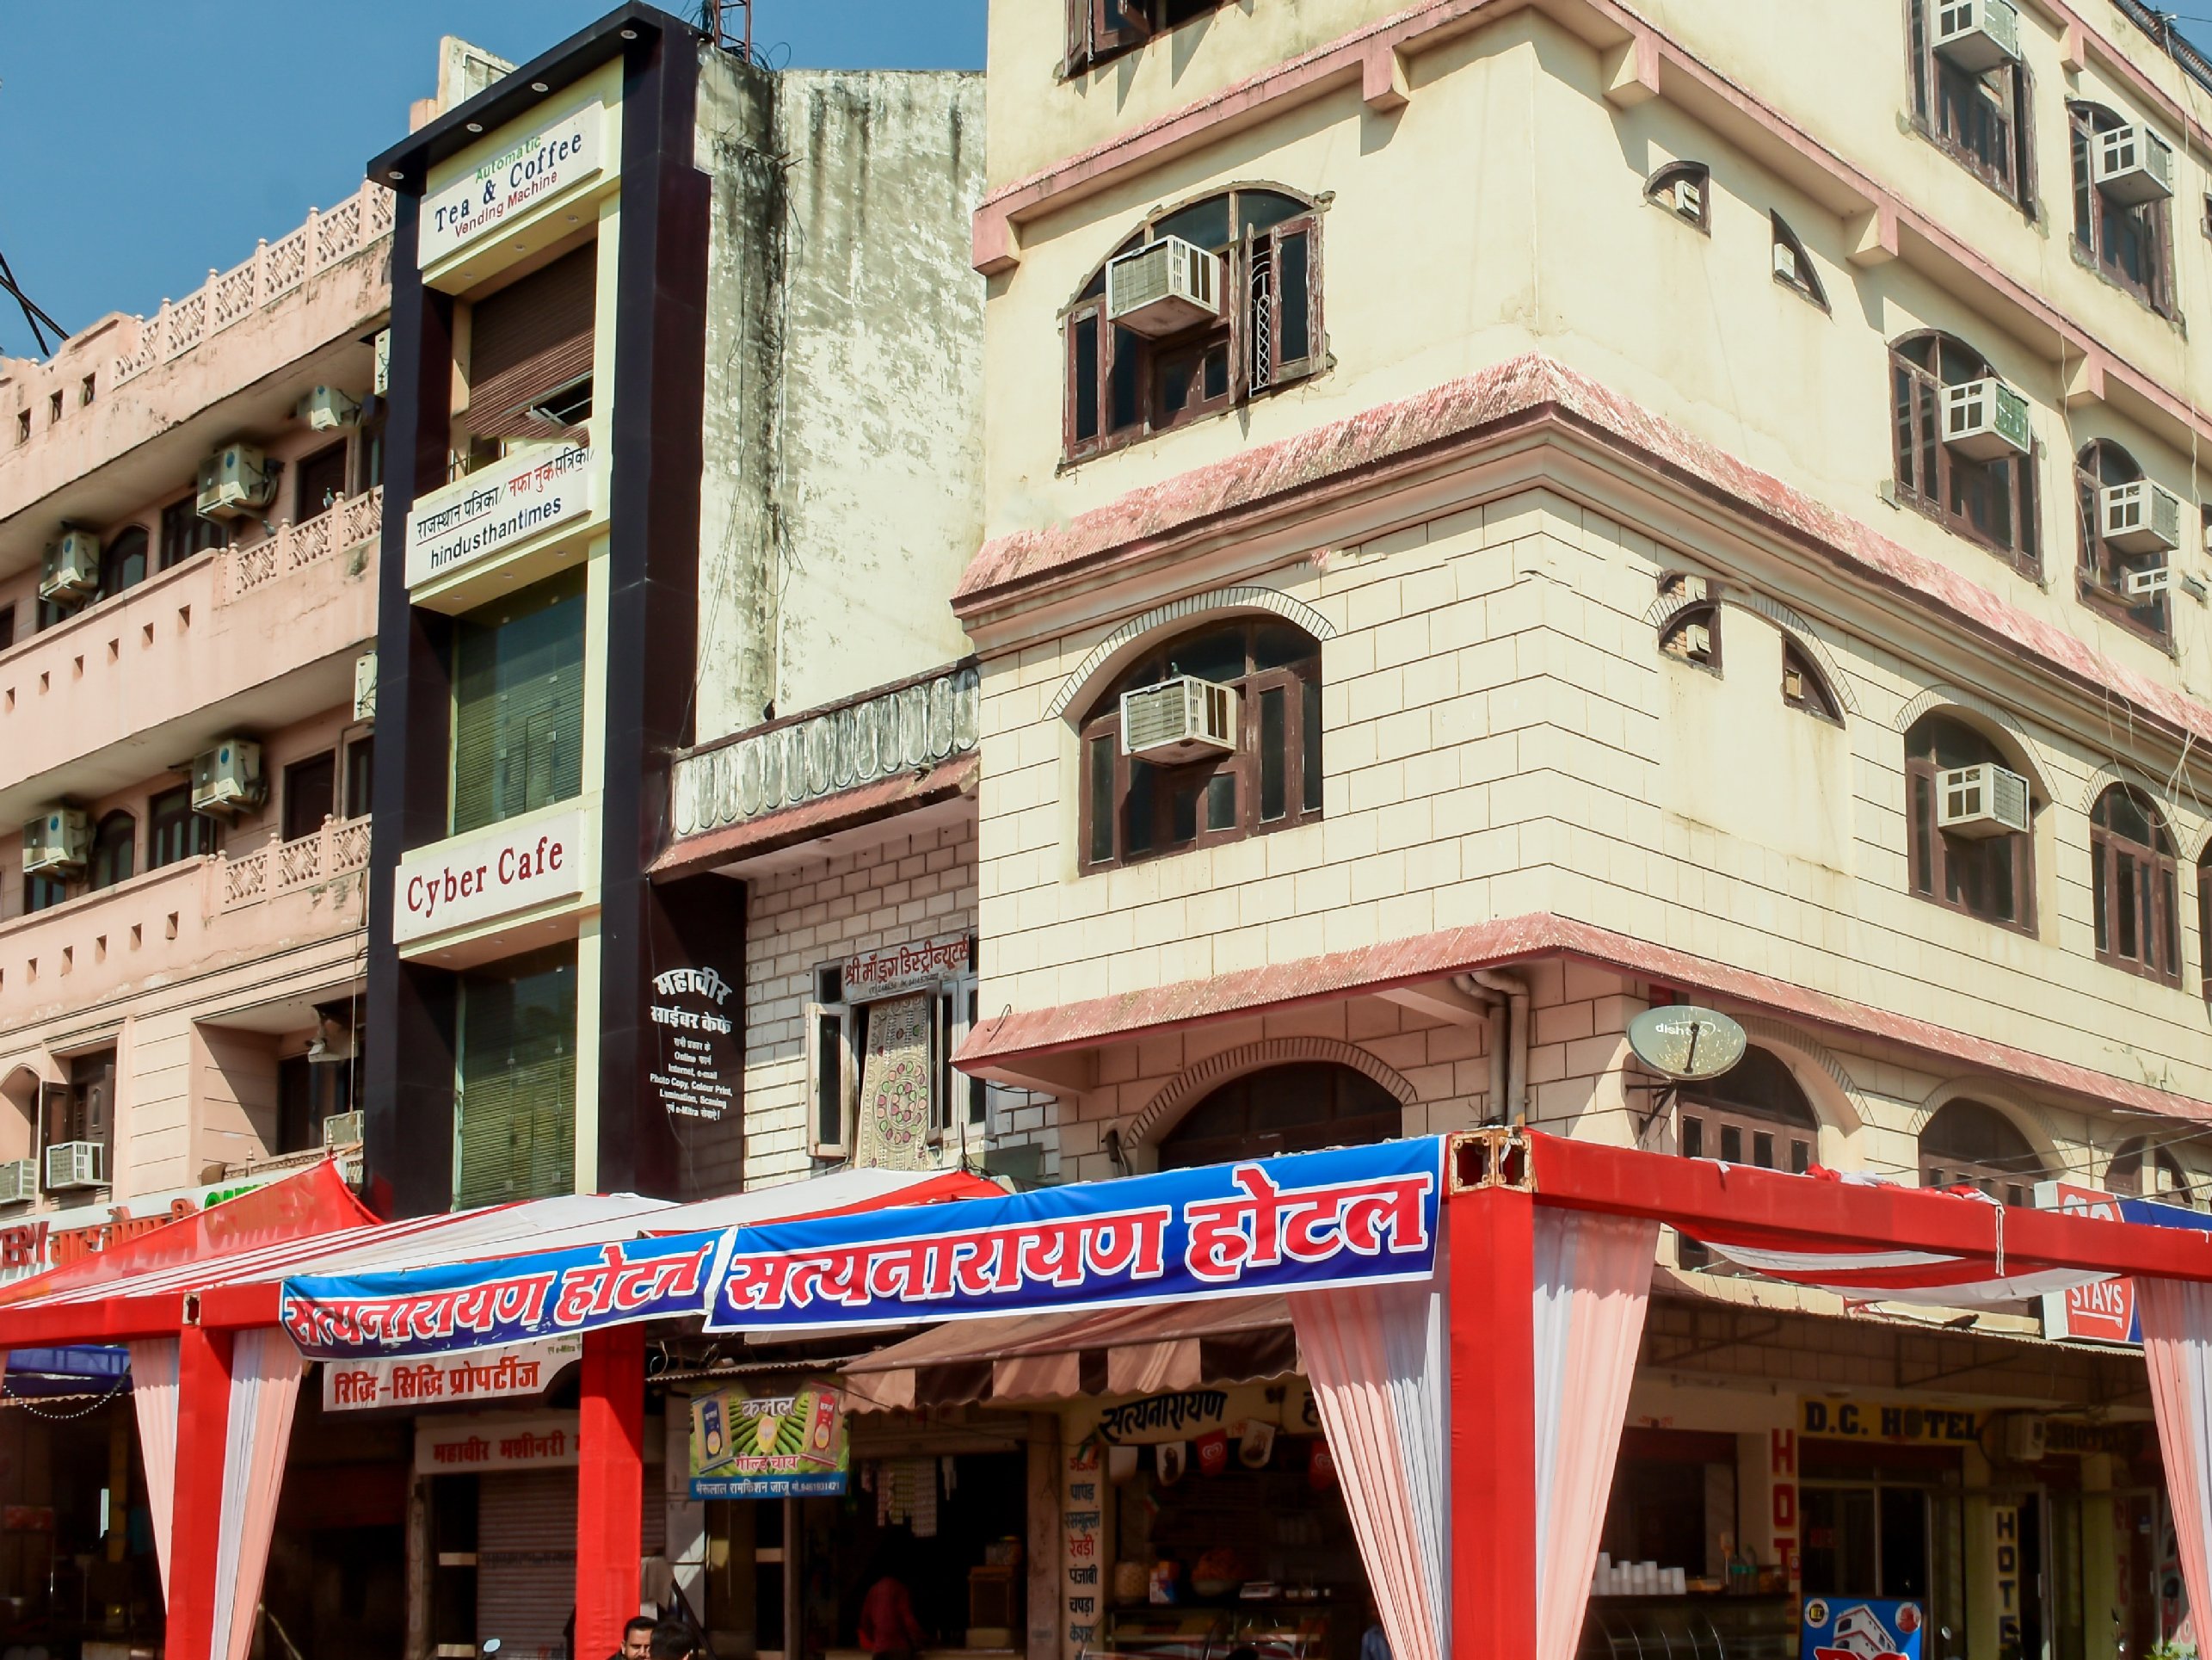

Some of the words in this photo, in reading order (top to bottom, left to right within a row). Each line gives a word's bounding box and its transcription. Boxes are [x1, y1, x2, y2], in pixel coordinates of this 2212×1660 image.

[476, 135, 542, 183] Automatic
[434, 198, 471, 232] Tea
[483, 179, 496, 205] &
[510, 133, 582, 188] Coffee
[508, 170, 558, 209] Machine
[416, 503, 462, 540] राजस्थान
[508, 472, 533, 497] नफा
[430, 497, 562, 570] hindusthantimes
[407, 866, 488, 918] Cyber
[497, 836, 564, 886] Cafe
[652, 966, 733, 1005] महावीर
[845, 956, 861, 986] श्री
[878, 956, 899, 984] ड्रग
[1655, 1022, 1710, 1038] disht
[674, 1051, 696, 1063] Online
[650, 1073, 670, 1084] Photo
[691, 1081, 714, 1093] Colour
[0, 1221, 49, 1268] ERY
[728, 1206, 1171, 1312] सत्यनारायण
[1185, 1165, 1433, 1282] होटल
[283, 1270, 558, 1348] सत्यनारायण
[449, 1355, 541, 1396] प्रोपर्टीज
[742, 1397, 797, 1418] कमल
[1099, 1390, 1229, 1443] सत्यनारायण
[1804, 1401, 1869, 1436] D.C.
[1880, 1407, 1980, 1441] HOTEL
[433, 1435, 491, 1465] महावीर
[499, 1429, 566, 1459] मशीनरी
[770, 1454, 801, 1472] चाय
[730, 1478, 767, 1495] रामकिशन
[1996, 1511, 2018, 1647] HOTE
